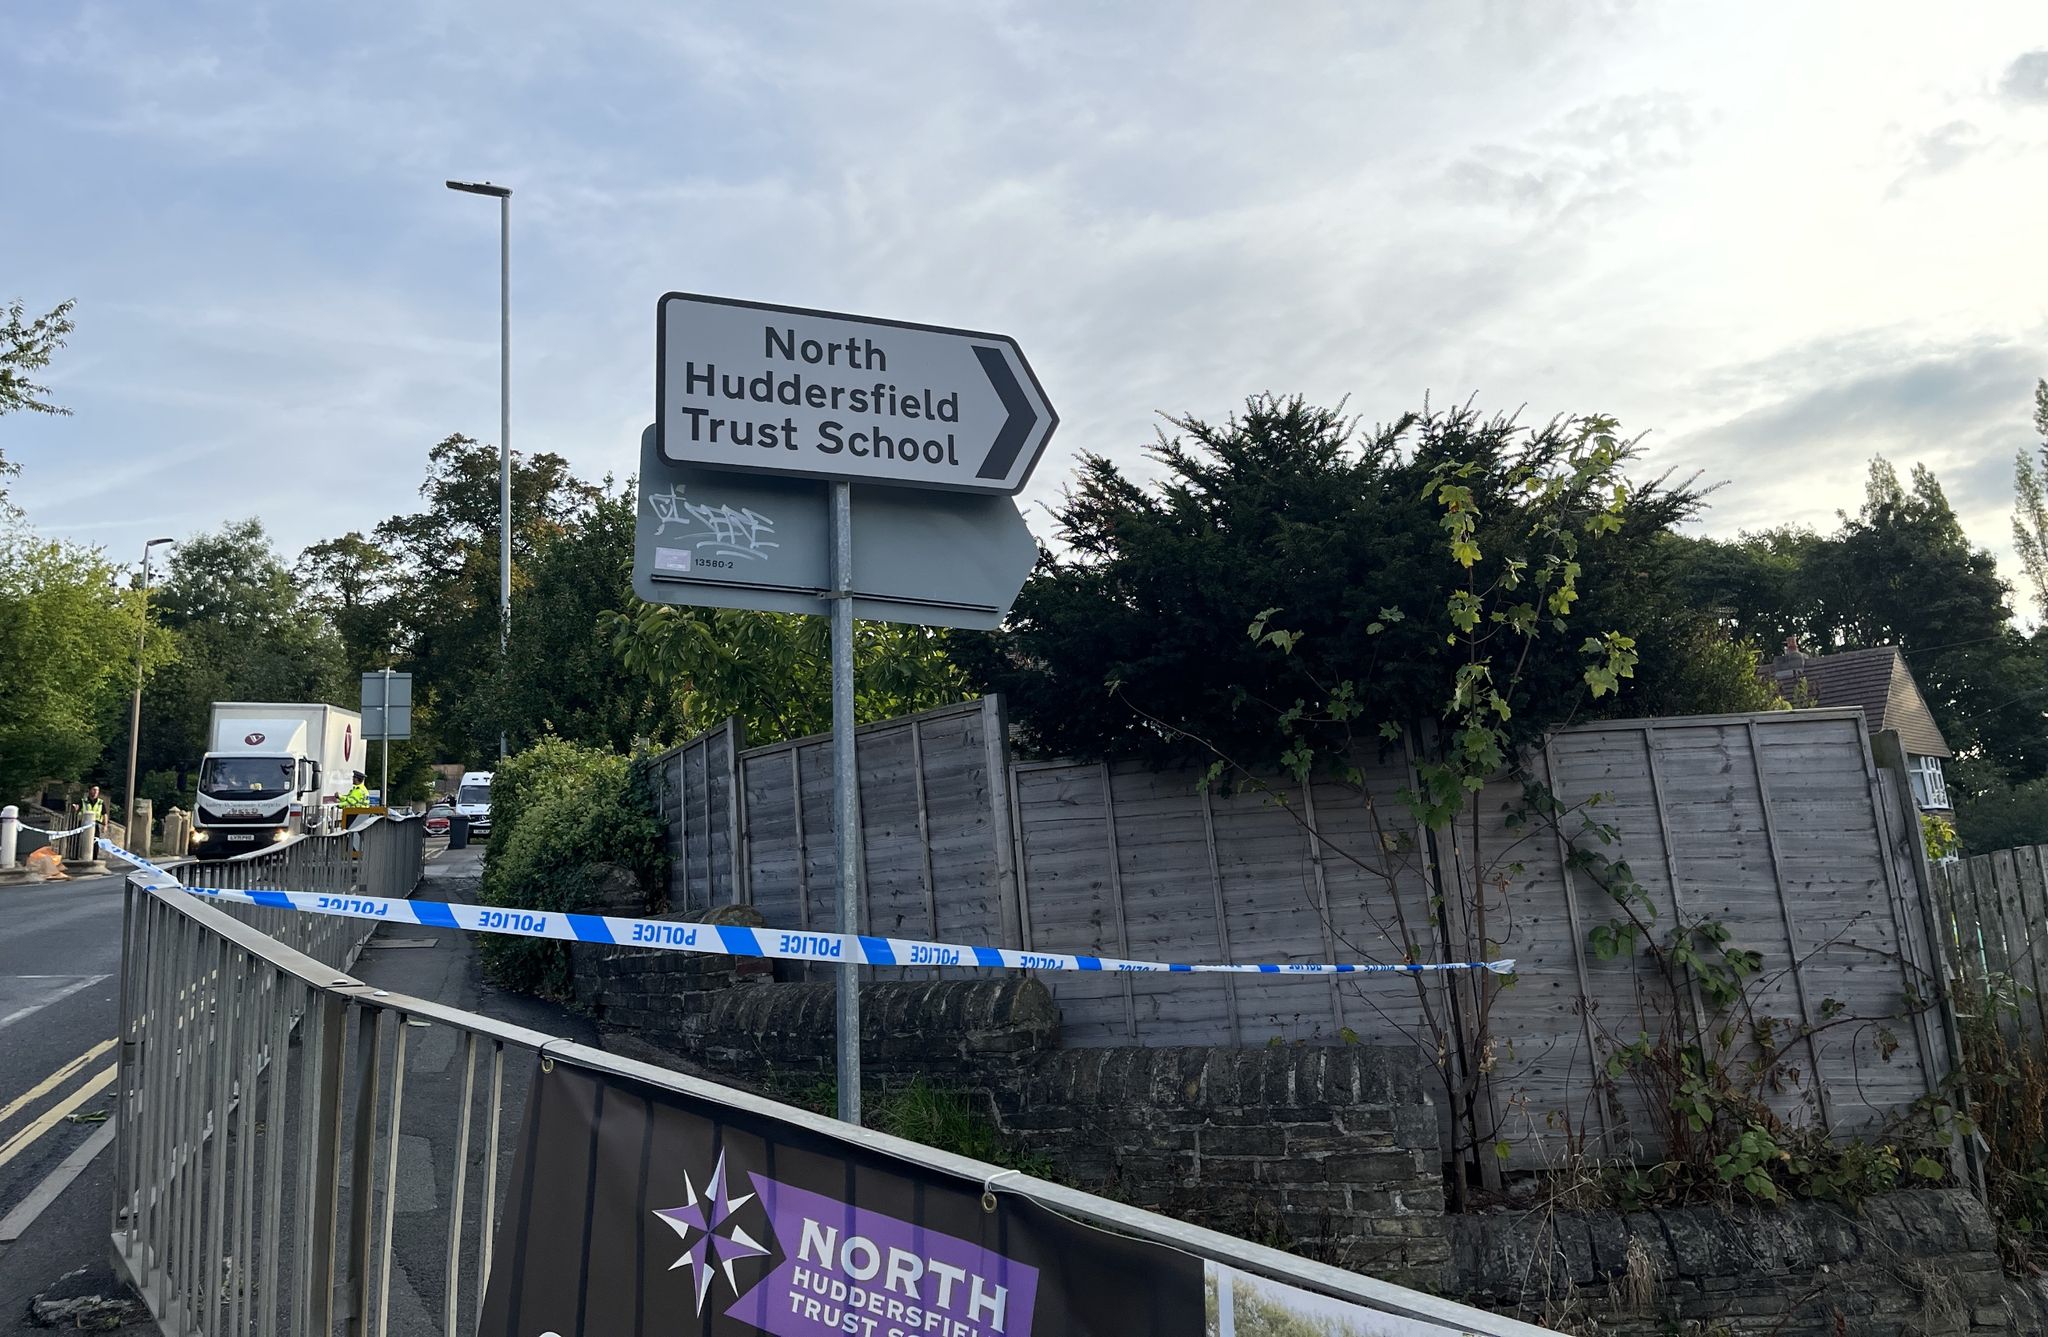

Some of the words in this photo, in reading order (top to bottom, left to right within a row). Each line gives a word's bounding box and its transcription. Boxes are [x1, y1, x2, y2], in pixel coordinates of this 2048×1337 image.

[764, 326, 887, 372] North
[685, 361, 959, 422] Huddersfield
[682, 406, 798, 451] Trust
[816, 421, 959, 466] School
[317, 896, 389, 916] POLICE
[478, 911, 546, 933] POLICE
[632, 923, 697, 946] POLICE
[779, 934, 842, 958] POLICE
[910, 945, 960, 966] POLICE
[797, 1217, 1008, 1334] NORTH
[789, 1291, 879, 1337] TRUST
[792, 1266, 990, 1337] HUDDERSFIE
